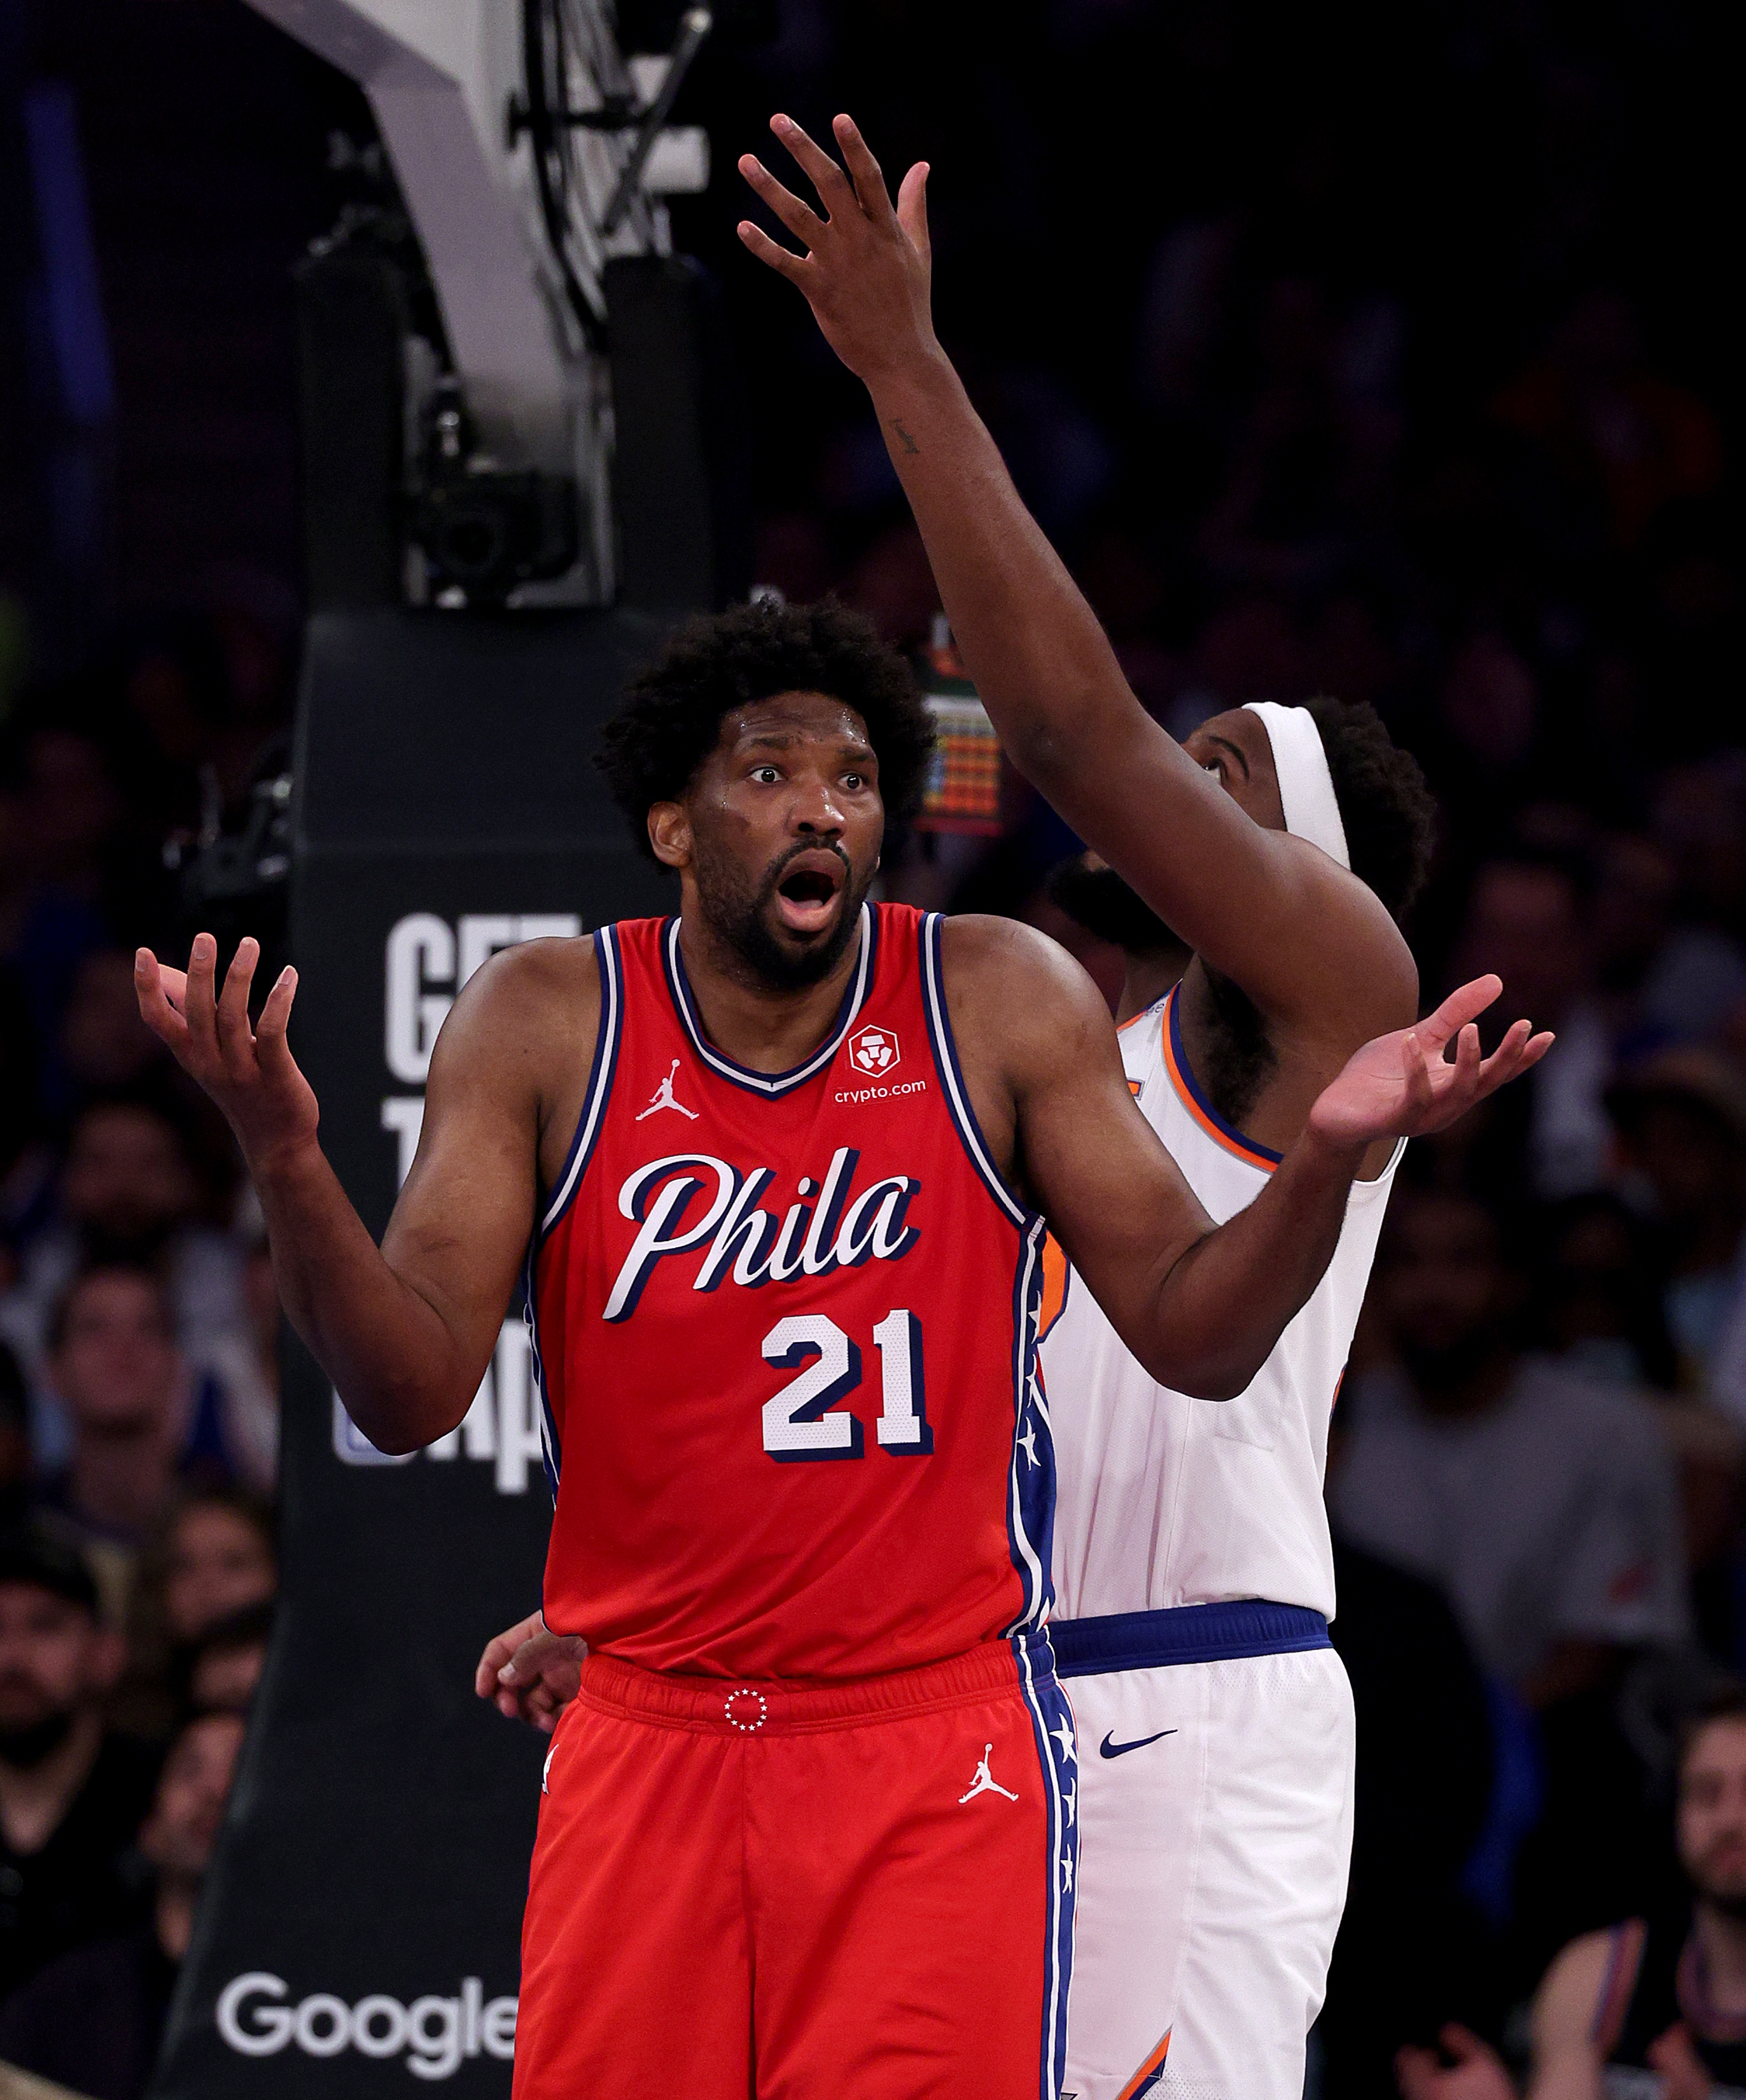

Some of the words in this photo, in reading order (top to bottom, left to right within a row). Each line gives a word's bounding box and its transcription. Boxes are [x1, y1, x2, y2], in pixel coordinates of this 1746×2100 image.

[835, 1080, 926, 1103] crypto.com
[602, 1147, 921, 1324] Phila
[761, 1308, 933, 1462] 21
[216, 1971, 521, 2080] Google
